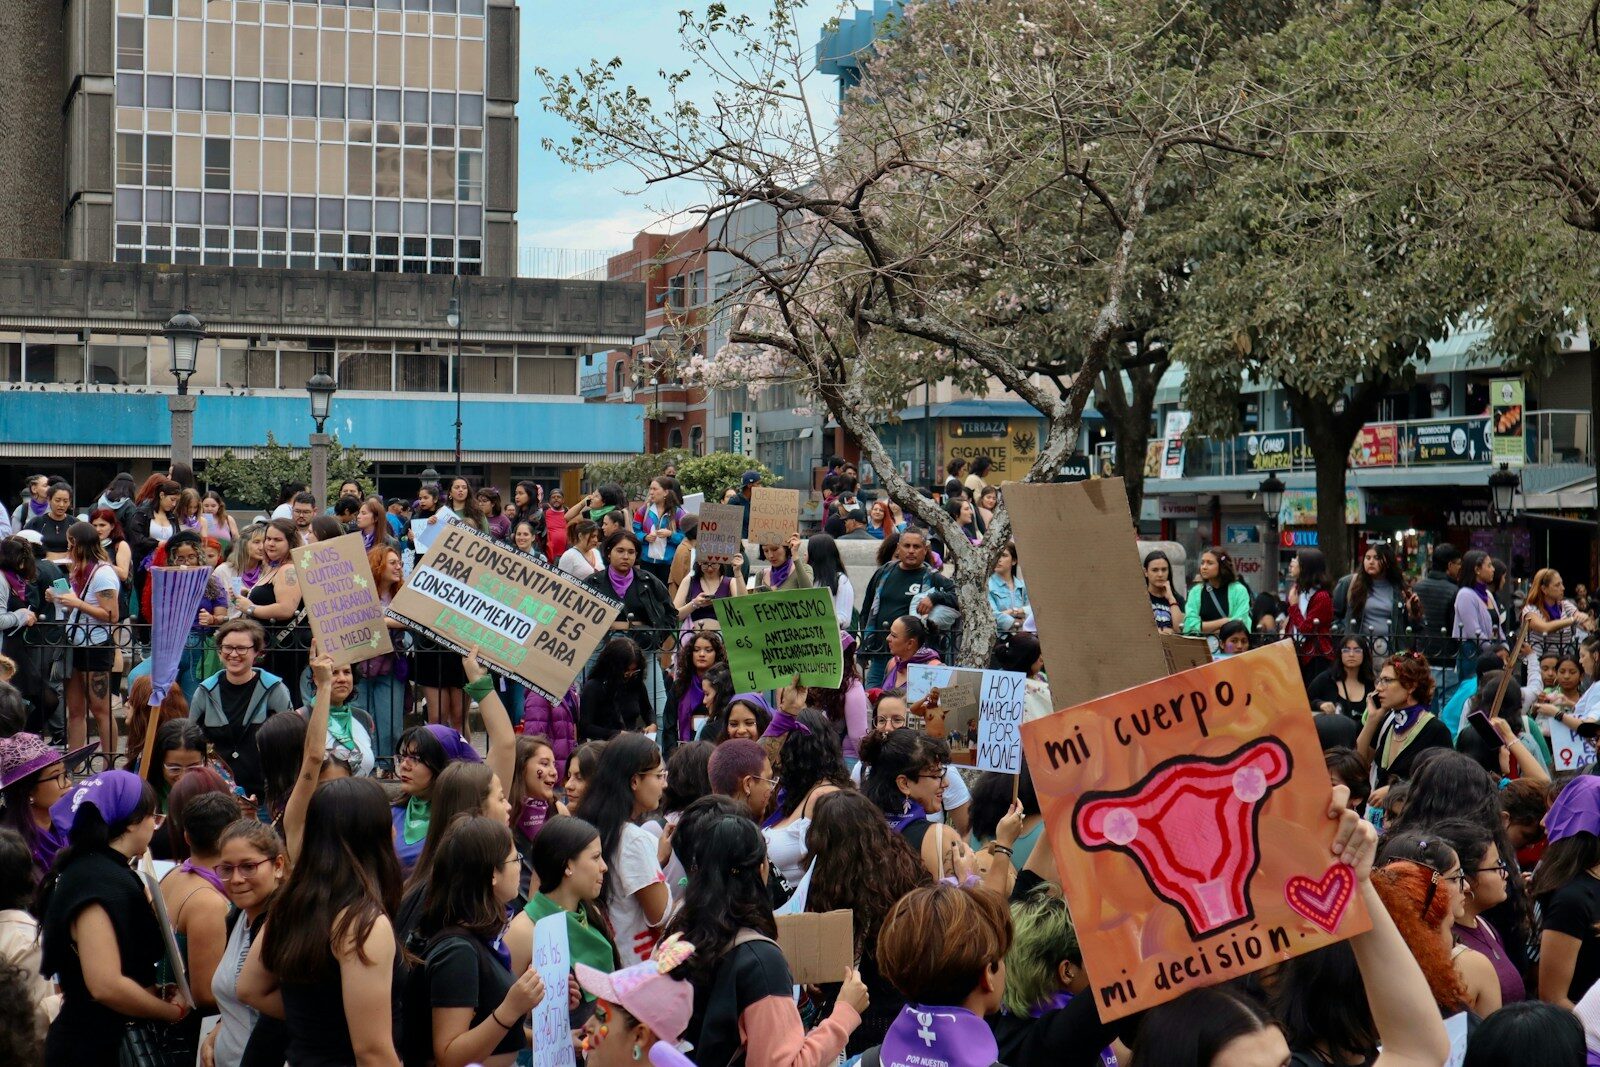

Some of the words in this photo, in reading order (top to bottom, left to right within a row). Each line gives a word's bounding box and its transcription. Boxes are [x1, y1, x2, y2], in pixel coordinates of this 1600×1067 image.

[962, 422, 1006, 433] TERRAZA
[700, 521, 717, 531] NO
[753, 518, 795, 530] TORTURA
[313, 546, 339, 564] NOS
[701, 543, 735, 554] STEM
[305, 560, 354, 585] QUITARON
[443, 531, 464, 554] EL
[465, 540, 607, 625] CONSENTIMIENTO
[320, 576, 354, 596] TANTO
[431, 552, 473, 585] PARA
[517, 594, 558, 625] NO
[556, 615, 586, 641] ES
[311, 600, 330, 618] QUE
[331, 588, 373, 613] ACABARON
[722, 599, 745, 627] Mi
[753, 598, 827, 623] FEMINISMO
[412, 570, 532, 640] CONSENTIMIENTO
[533, 631, 577, 667] PARA
[324, 638, 339, 653] EL
[340, 627, 372, 648] MIEDO
[736, 635, 752, 649] es
[988, 674, 1022, 700] HOY
[979, 701, 1022, 721] MARCHO
[988, 722, 1015, 743] POR
[1044, 724, 1090, 770] mi
[1114, 680, 1253, 746] cuerpo,
[977, 738, 1020, 770] MONÉ
[1100, 969, 1137, 1008] mi
[905, 1055, 920, 1065] POR
[920, 1057, 949, 1067] NUESTRO
